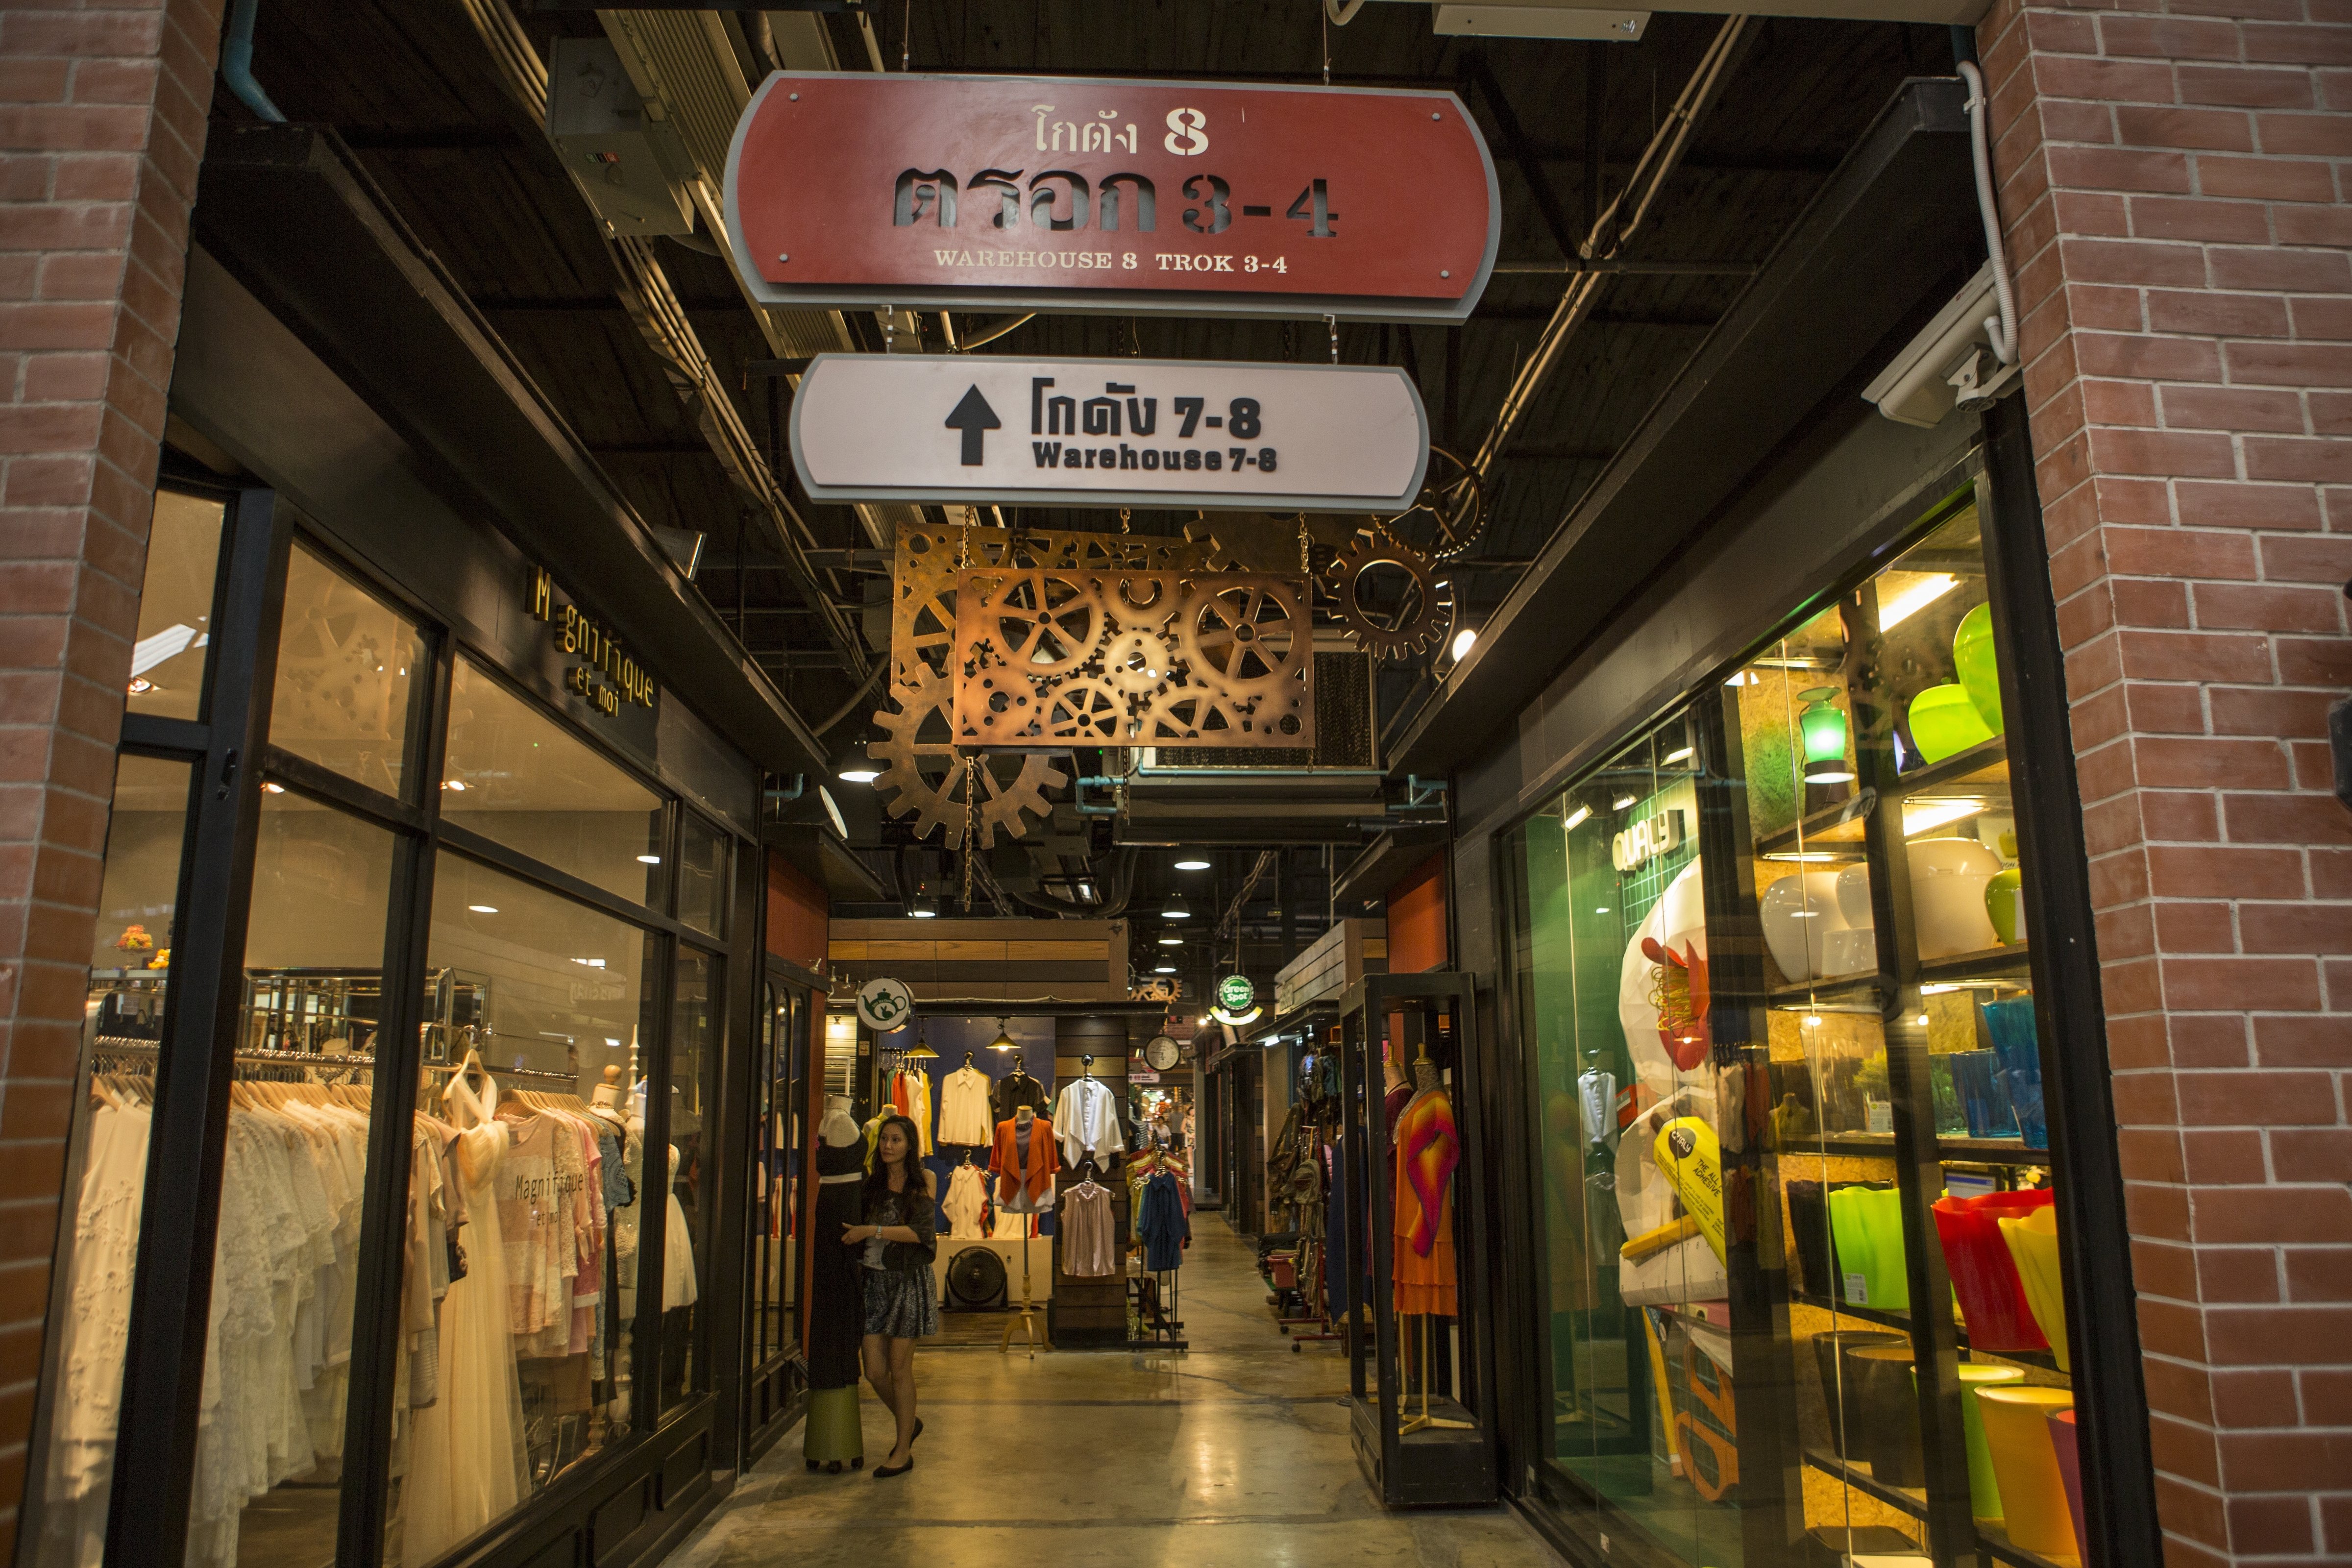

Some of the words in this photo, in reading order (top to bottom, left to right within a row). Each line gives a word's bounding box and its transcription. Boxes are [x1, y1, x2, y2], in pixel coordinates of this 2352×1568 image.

[1031, 105, 1138, 154] โกดัง
[1164, 107, 1210, 156] 8
[894, 168, 1156, 232] ตรอก
[1182, 174, 1339, 237] 3-4
[933, 249, 1113, 270] WAREHOUSE
[1121, 252, 1138, 271] 8
[1156, 252, 1235, 273] TROK
[1244, 255, 1288, 274] 3-4
[1031, 377, 1157, 437] โกดัง
[1175, 397, 1263, 439] 7-8
[1032, 441, 1222, 471] Warehouse
[1229, 447, 1278, 473] 7-8
[577, 667, 591, 696] et
[599, 684, 618, 717] moi
[1612, 809, 1670, 871] QUALY
[1224, 984, 1249, 993] Green
[1227, 993, 1248, 1002] Spot
[1671, 1131, 1691, 1152] QUALY
[1693, 1168, 1721, 1197] ADHESIVE
[1697, 1158, 1710, 1173] THE
[1709, 1172, 1719, 1185] ALL
[515, 1170, 584, 1205] Magnifique
[537, 1211, 545, 1226] et
